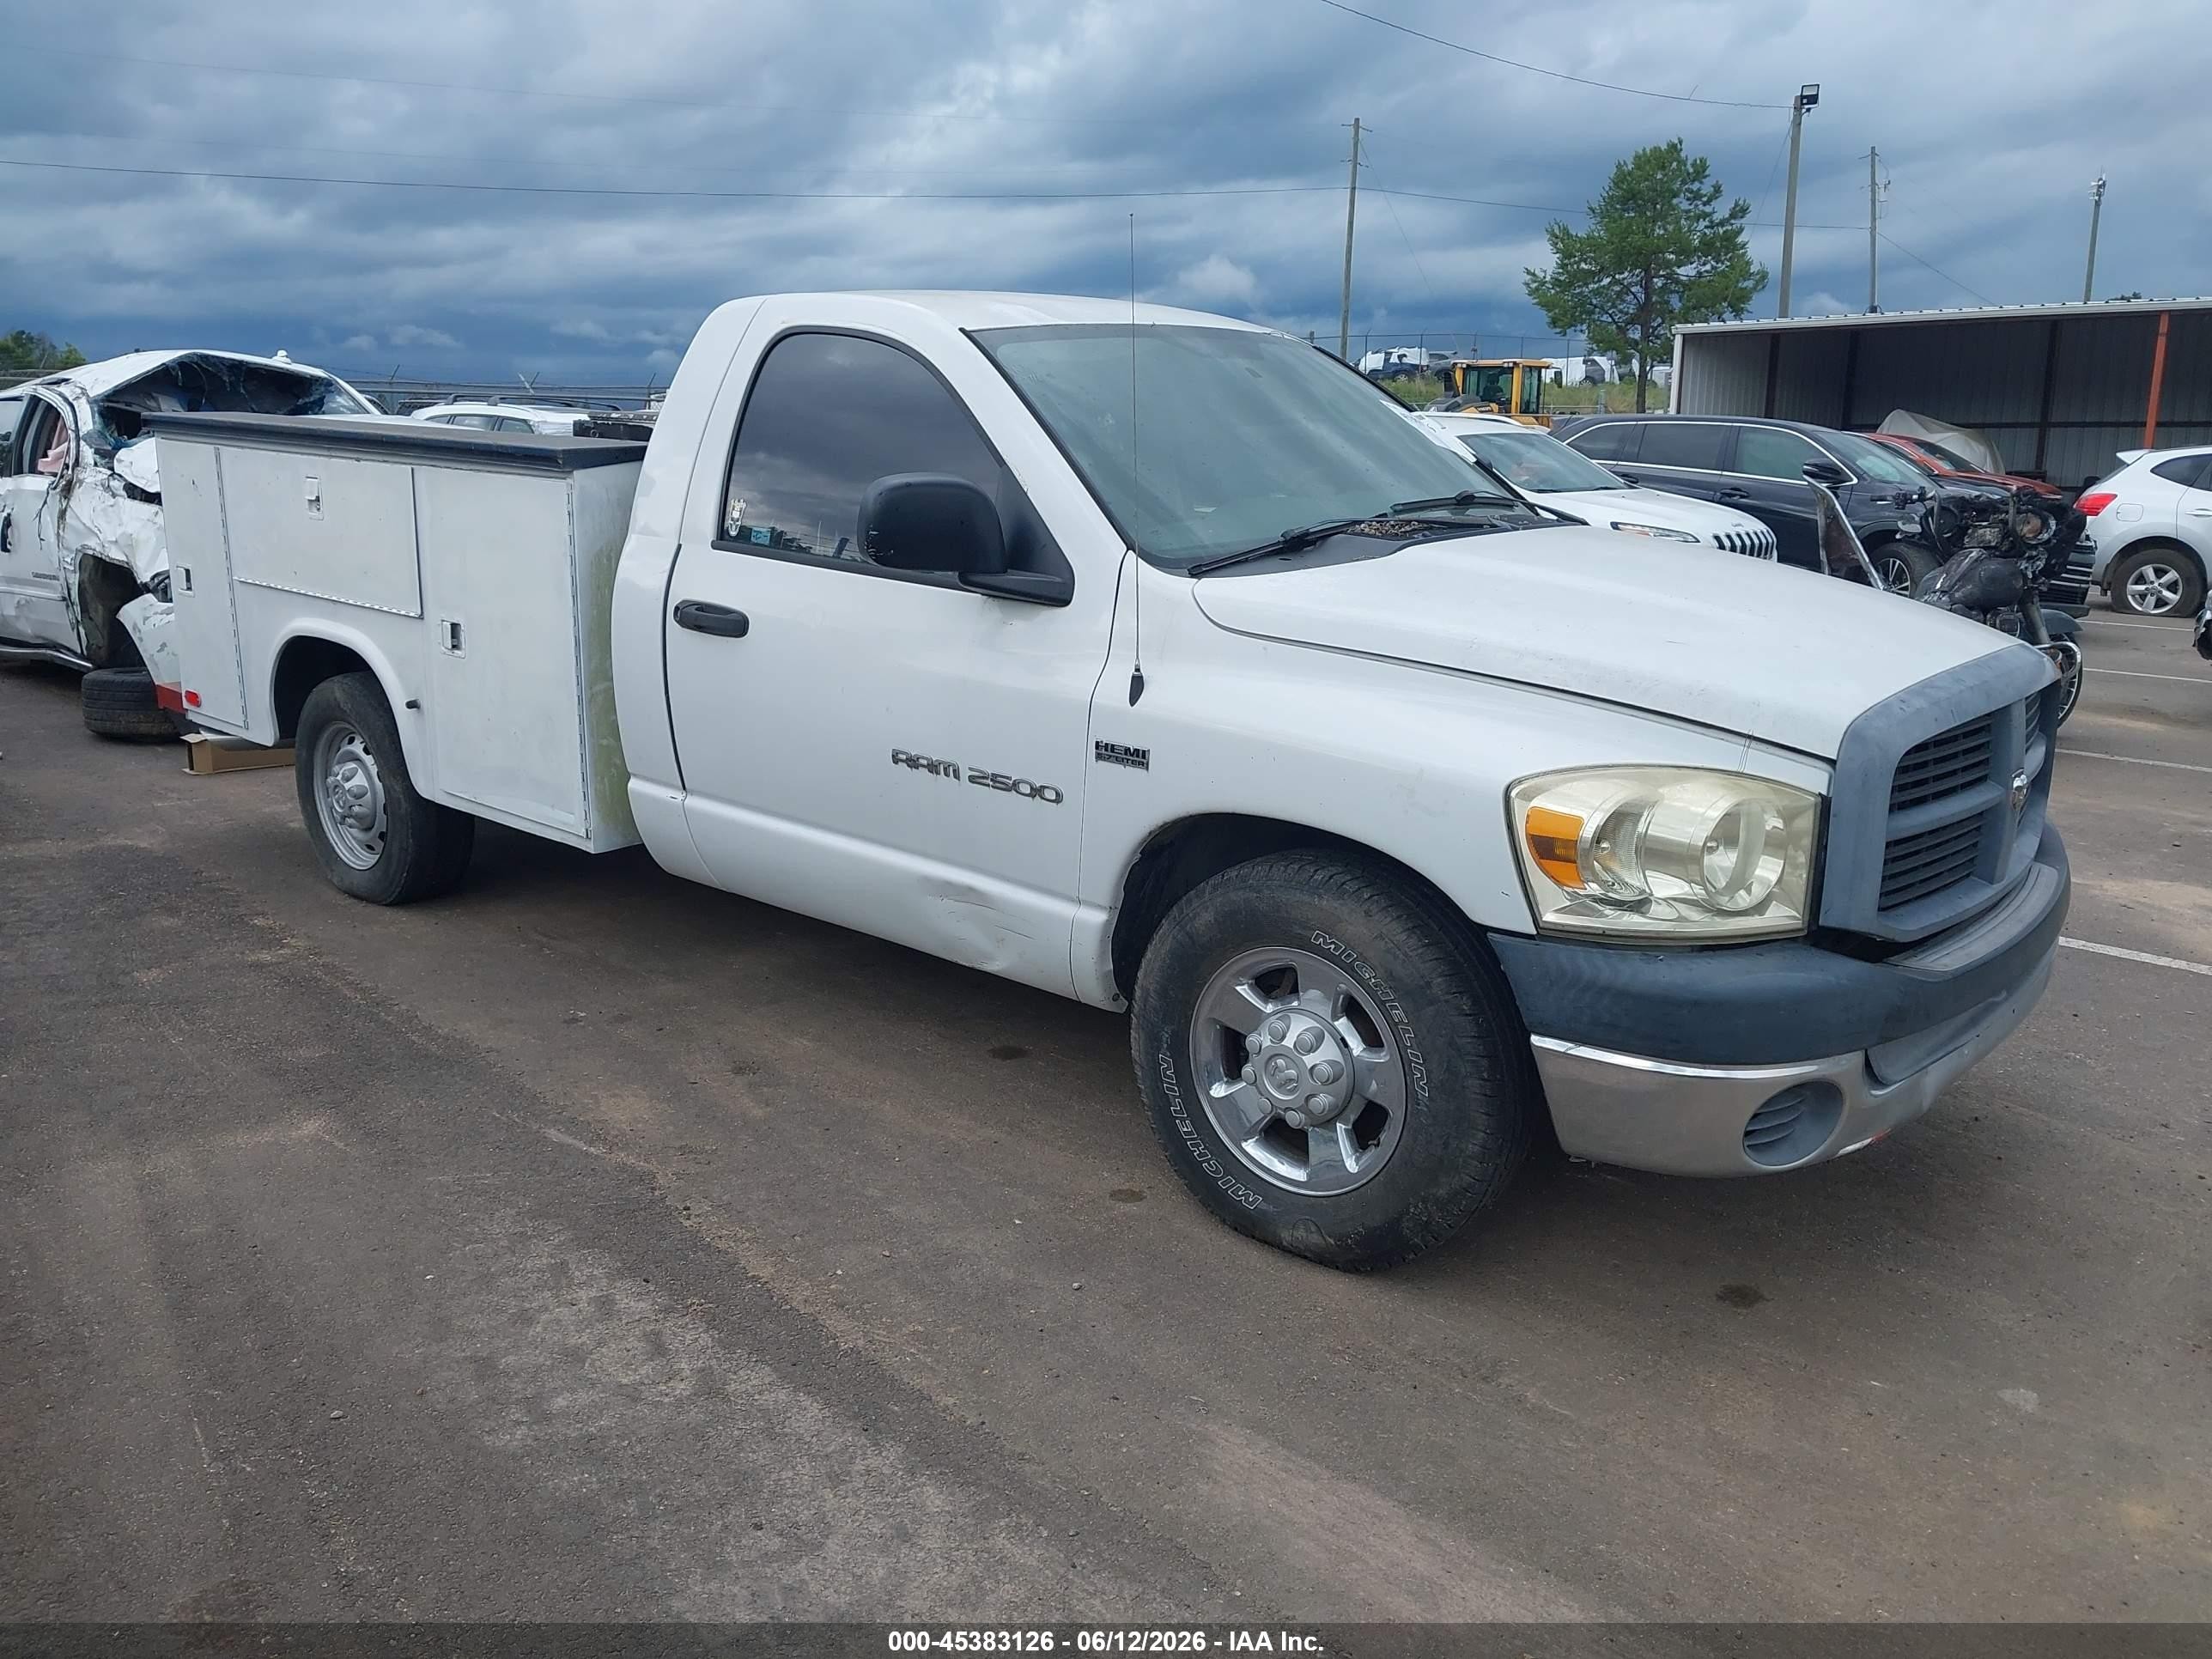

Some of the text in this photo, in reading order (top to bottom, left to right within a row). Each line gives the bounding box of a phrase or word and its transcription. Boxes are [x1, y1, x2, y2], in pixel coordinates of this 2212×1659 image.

[891, 748, 1064, 805] RAM 2500
[1095, 740, 1146, 760] HEMI
[1115, 756, 1146, 767] LITER
[1310, 930, 1429, 1097] MICHELIN
[1158, 1054, 1263, 1210] MICHELIN
